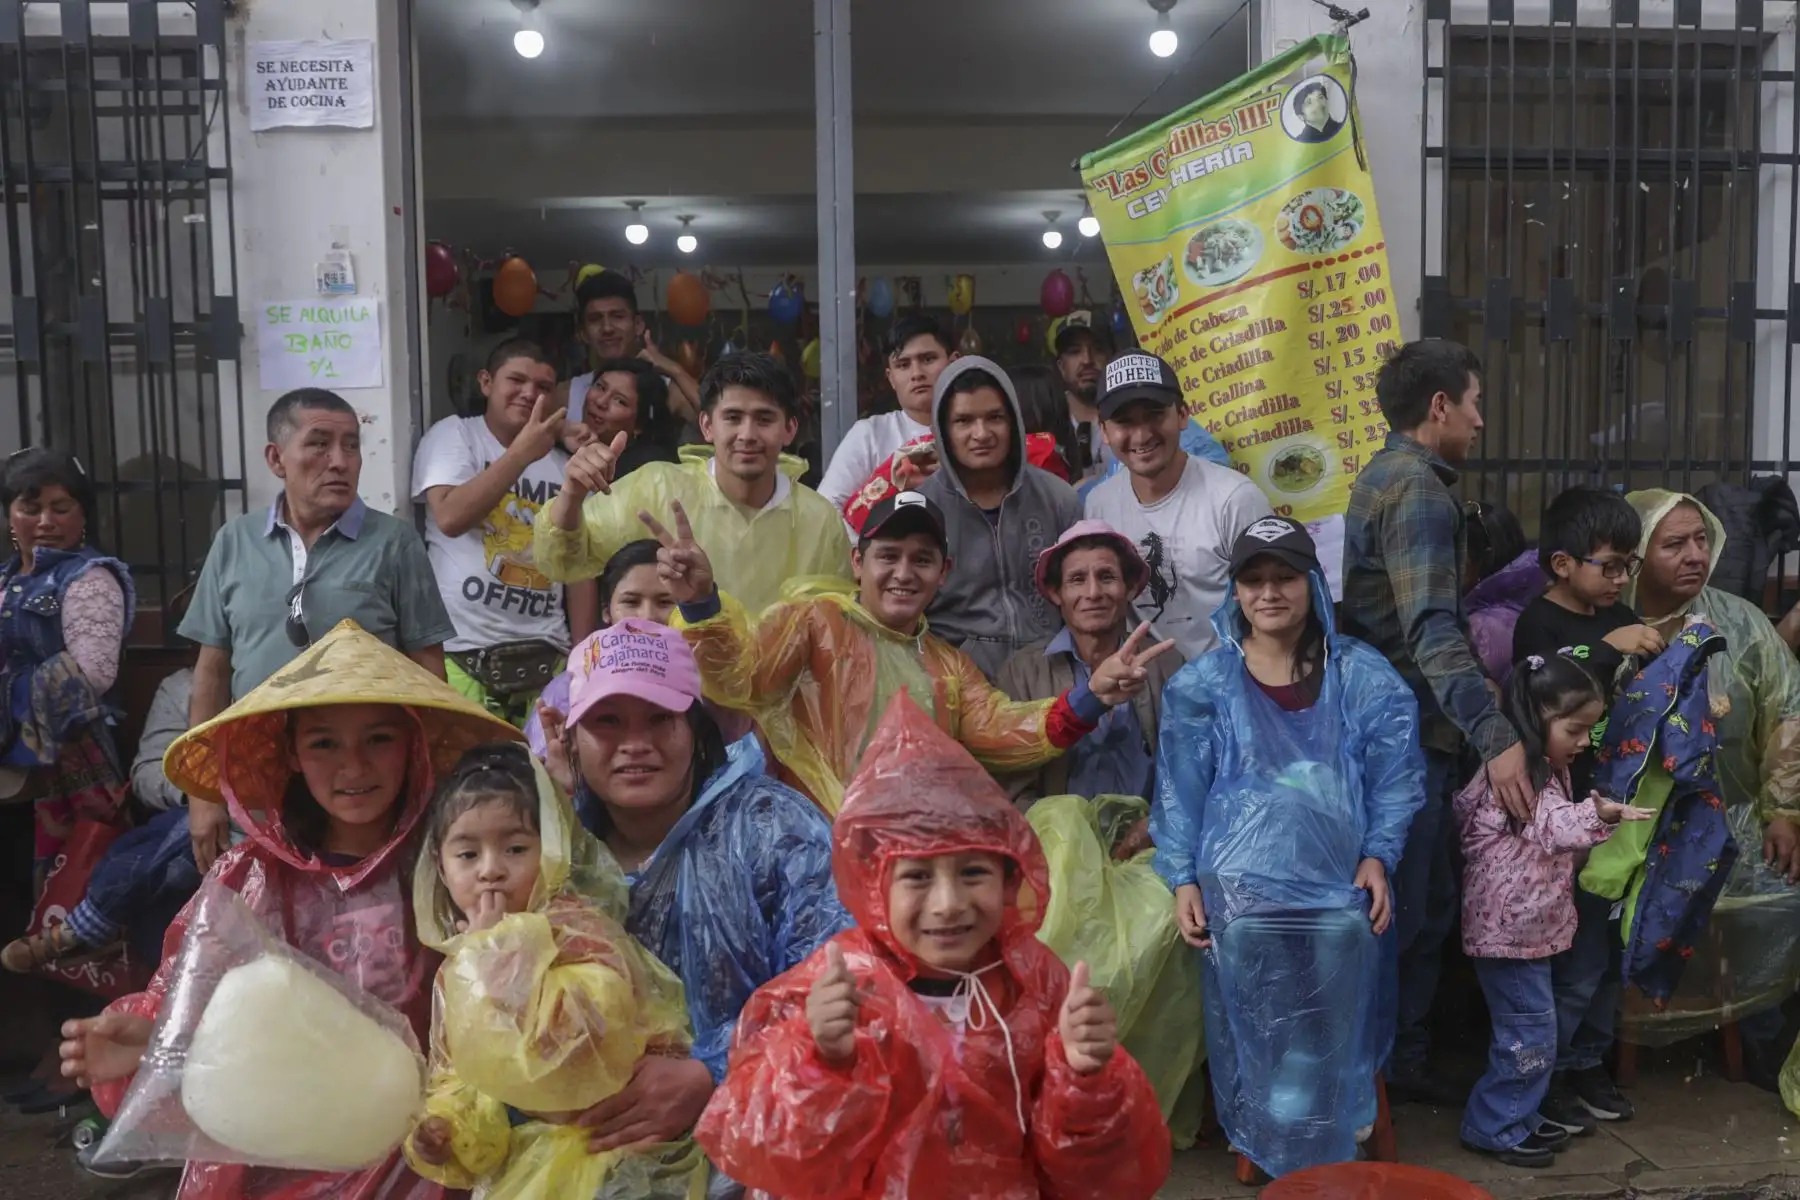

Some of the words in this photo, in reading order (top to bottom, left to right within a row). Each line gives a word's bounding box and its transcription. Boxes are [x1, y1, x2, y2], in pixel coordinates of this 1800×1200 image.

[256, 61, 276, 74] SE
[279, 60, 354, 73] NECESITA
[264, 77, 349, 92] AYUDANTE
[267, 96, 288, 109] DE
[290, 95, 346, 107] COCINA
[266, 305, 292, 324] SE
[299, 305, 371, 324] ALQUILA
[1174, 328, 1188, 345] de
[1189, 304, 1250, 335] Cabeza
[284, 330, 353, 353] BAÑO
[1189, 344, 1208, 363] de
[1209, 317, 1287, 354] Criadilla
[1107, 356, 1159, 375] ADDICTED
[1183, 375, 1201, 393] de
[1202, 347, 1275, 384] Criadilla
[1107, 371, 1123, 388] TO
[1209, 377, 1267, 408] Gallina
[1224, 393, 1302, 428] Criadilla
[1237, 417, 1316, 449] criadilla
[462, 576, 557, 618] OFFICE
[601, 633, 669, 651] Carnaval
